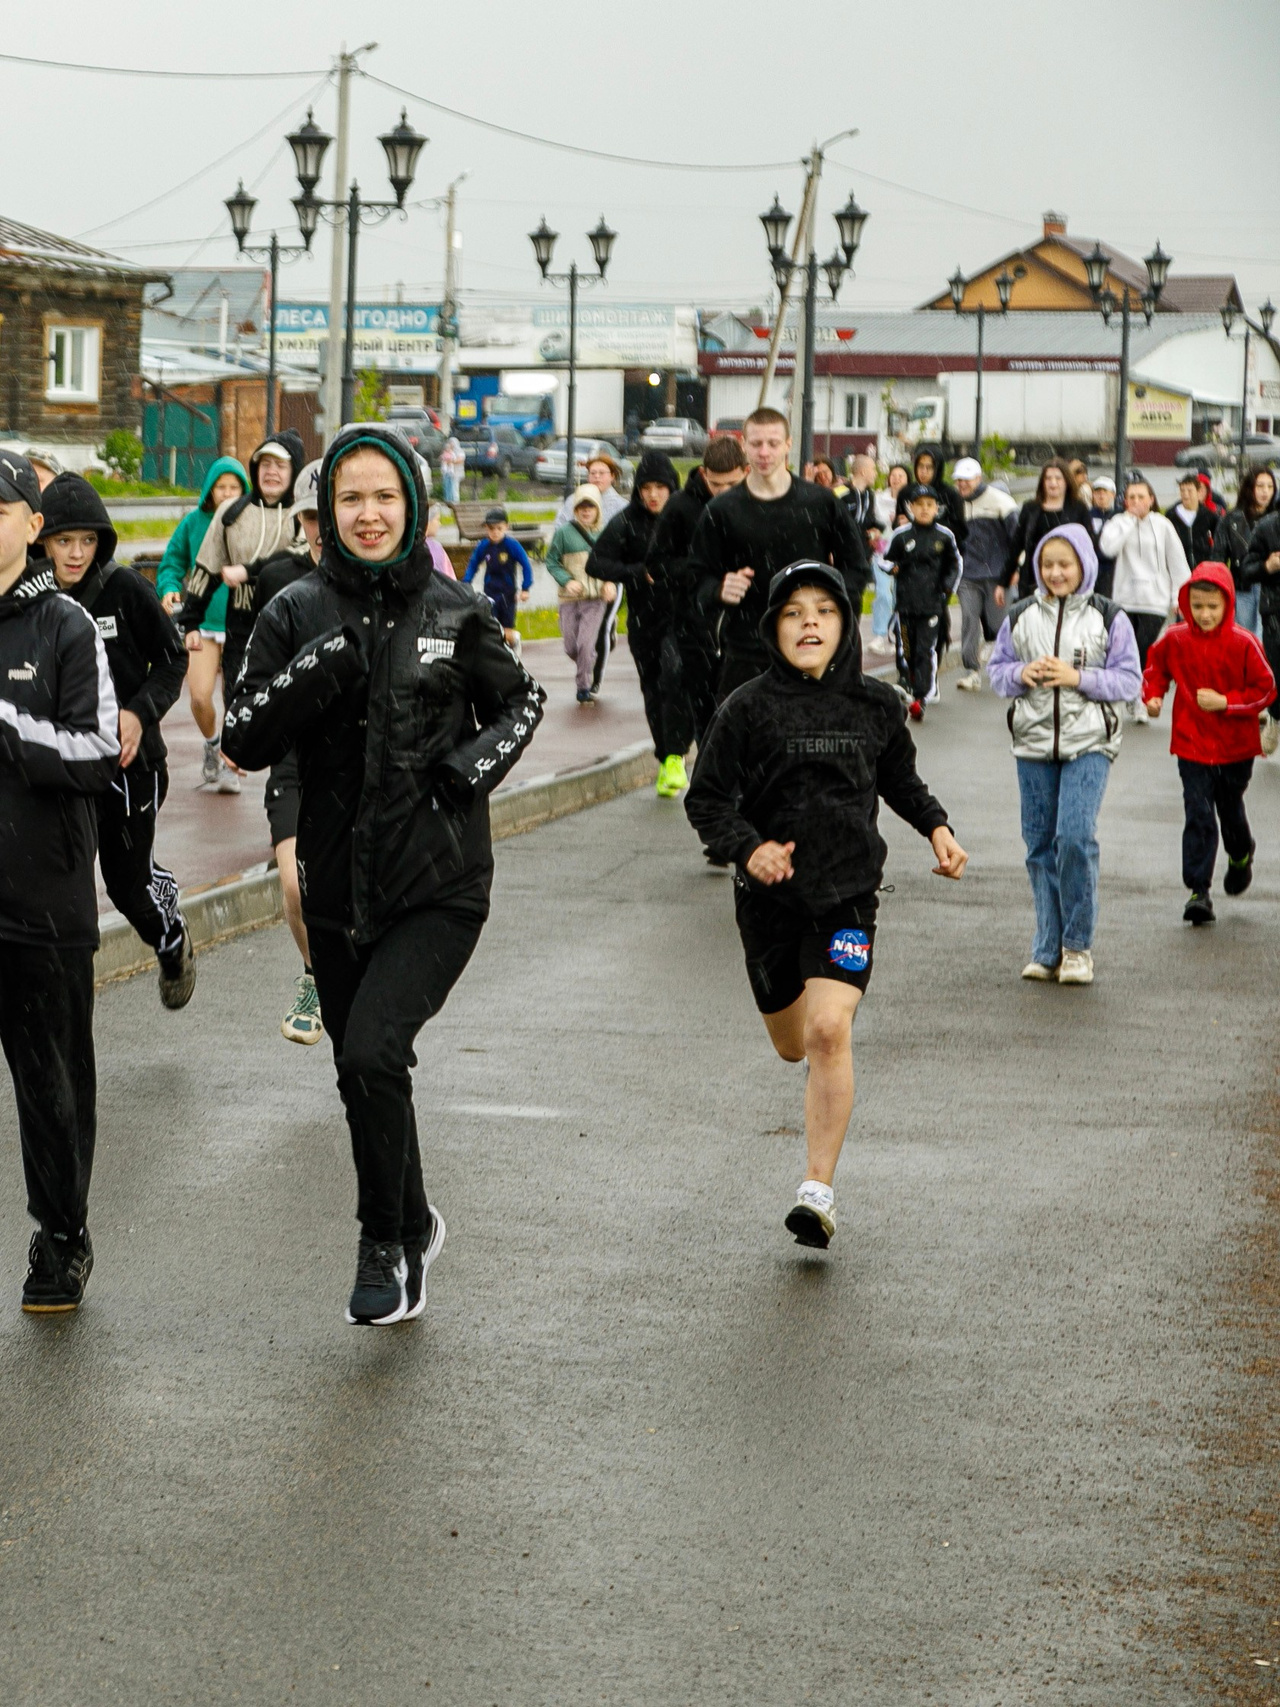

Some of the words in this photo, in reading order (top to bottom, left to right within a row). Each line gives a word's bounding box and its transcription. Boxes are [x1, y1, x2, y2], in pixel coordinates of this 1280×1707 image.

[354, 308, 428, 328] ГОДНО
[539, 309, 668, 324] ШИОМОНТАЖ
[417, 636, 456, 656] PUMA
[786, 738, 859, 754] ETERNITY
[833, 939, 868, 962] NASA
